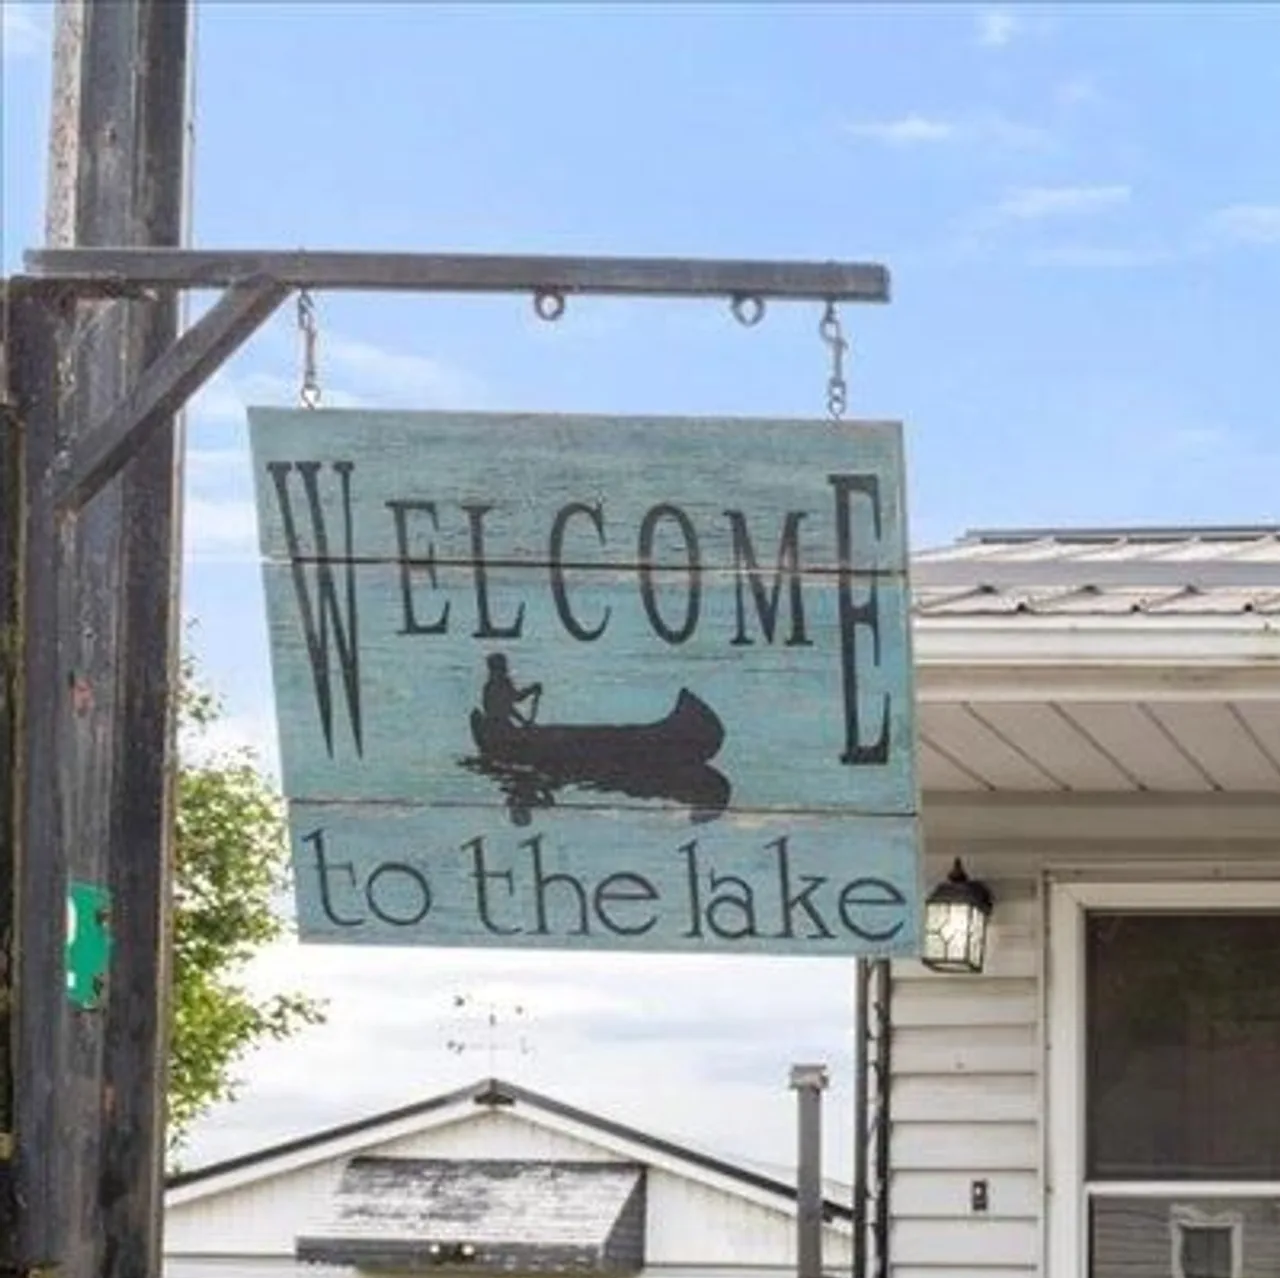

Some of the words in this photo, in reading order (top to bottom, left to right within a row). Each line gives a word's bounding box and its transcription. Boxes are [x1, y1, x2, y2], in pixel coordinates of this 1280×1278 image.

[266, 461, 891, 765] WELCOME
[302, 828, 432, 927] to
[460, 832, 660, 937] the
[679, 834, 907, 942] lake
